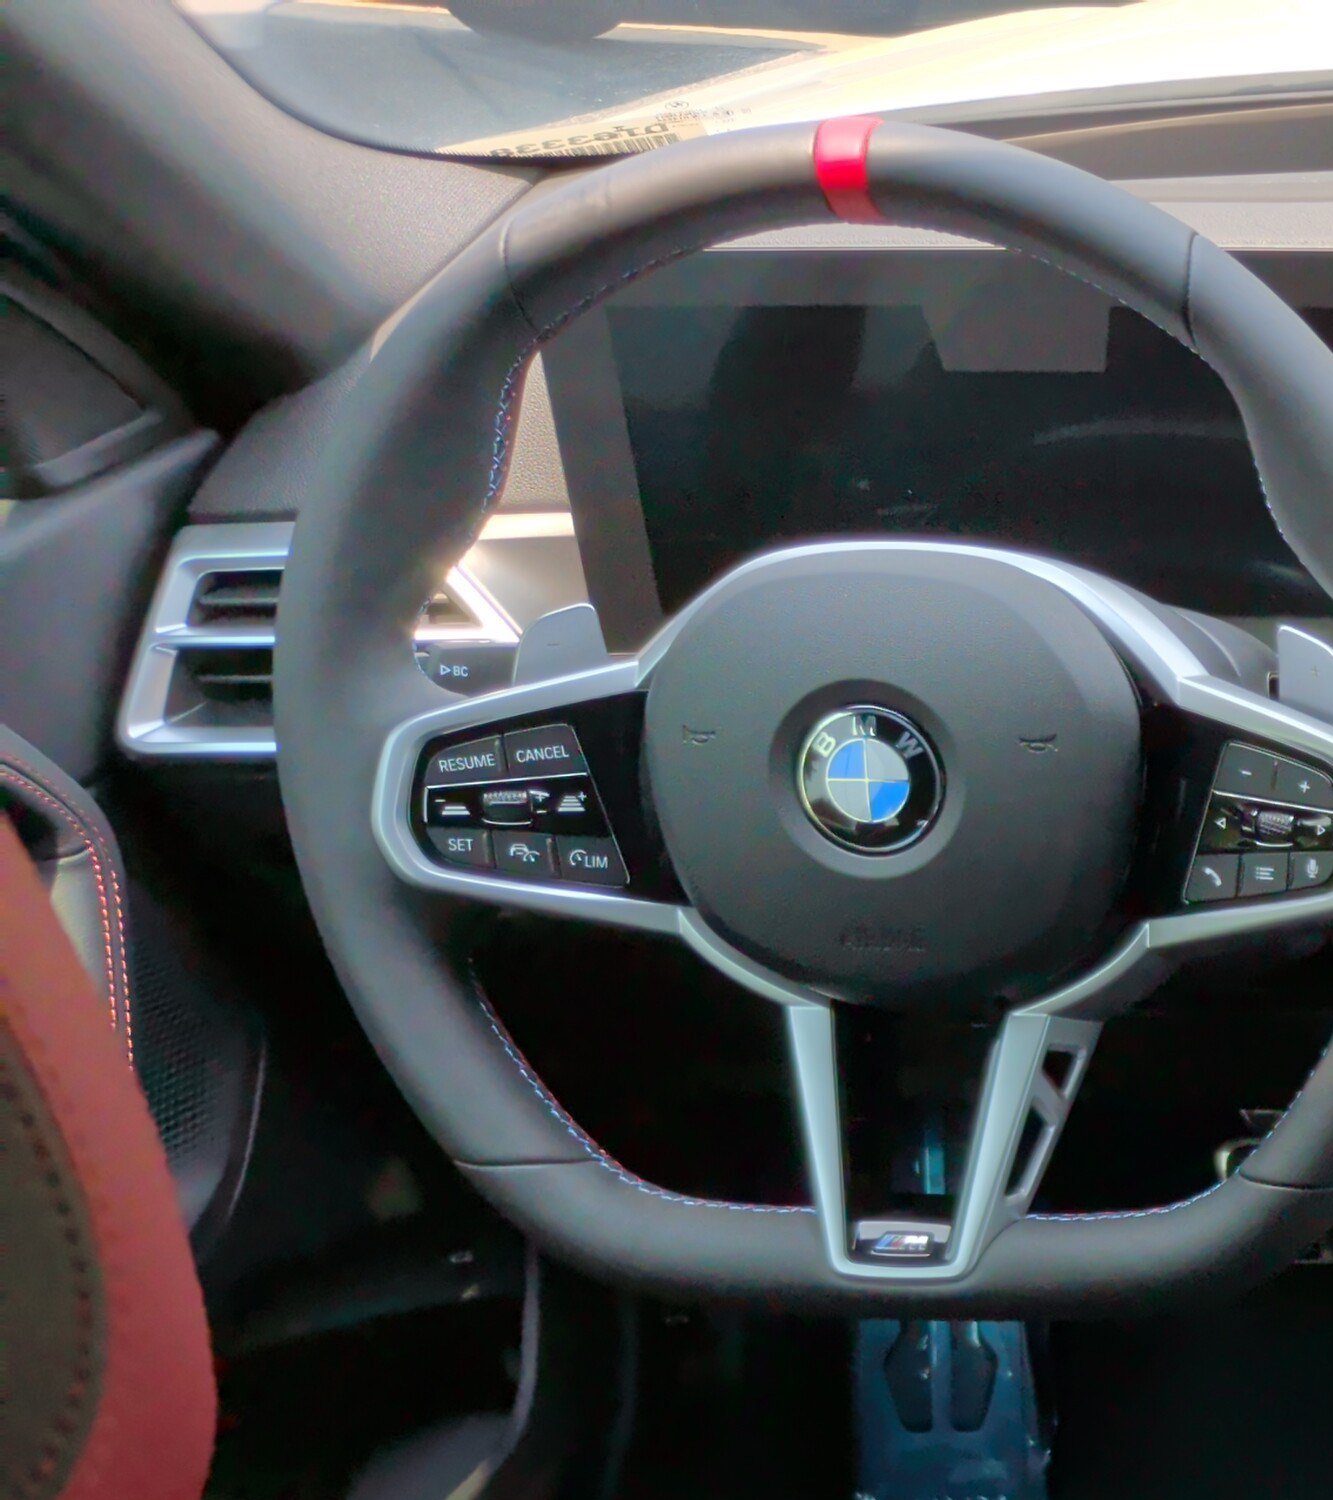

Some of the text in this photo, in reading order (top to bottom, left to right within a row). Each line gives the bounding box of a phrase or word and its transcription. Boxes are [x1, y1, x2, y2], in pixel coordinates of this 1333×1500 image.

[453, 665, 469, 678] BC
[812, 715, 924, 759] BMW
[515, 745, 570, 763] CANCEL
[438, 752, 496, 773] RESUME
[448, 838, 474, 852] SET
[584, 855, 609, 869] LIM
